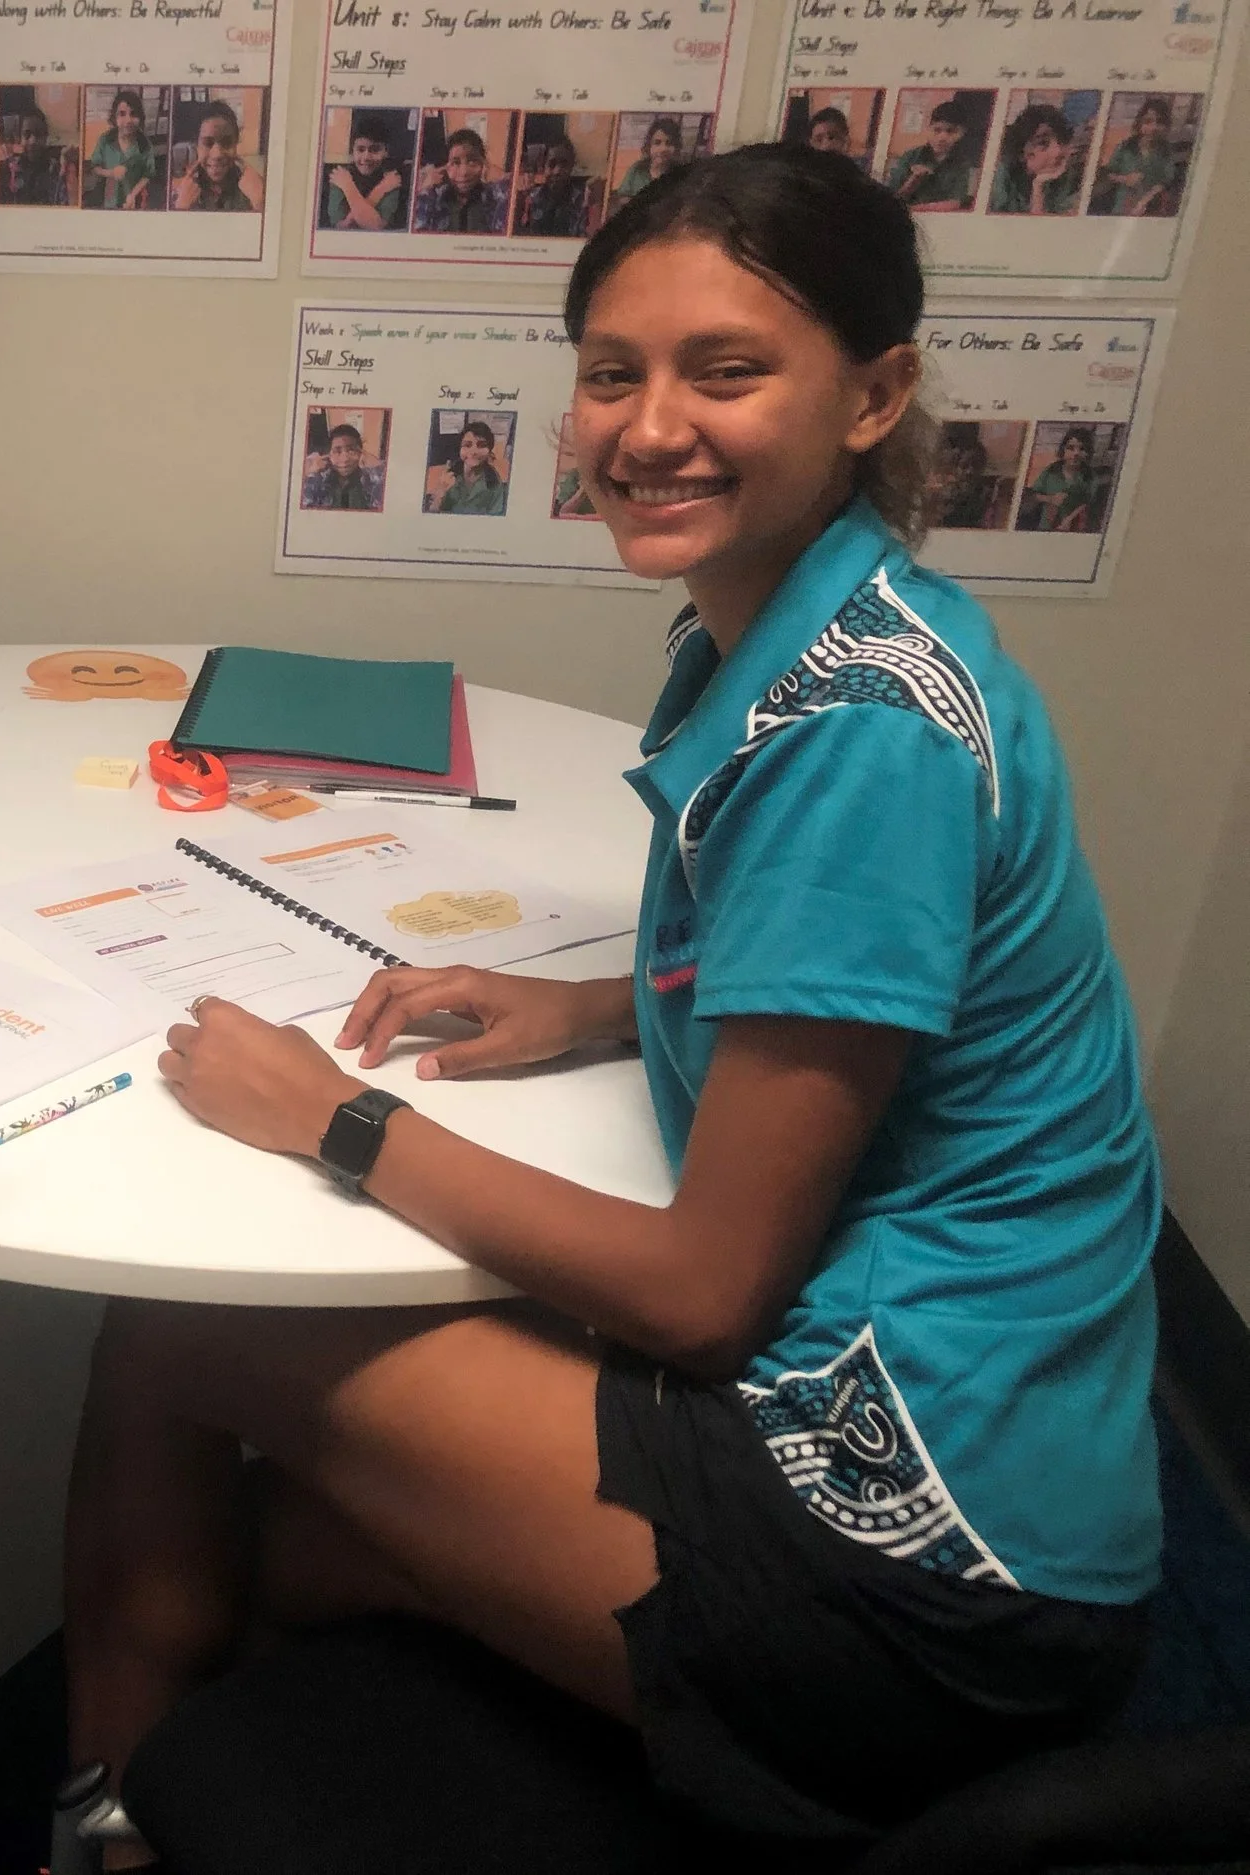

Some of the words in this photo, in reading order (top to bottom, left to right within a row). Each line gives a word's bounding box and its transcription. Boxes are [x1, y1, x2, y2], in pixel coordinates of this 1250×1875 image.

[35, 2, 66, 18] with
[73, 0, 122, 19] Others:
[129, 1, 148, 19] Be
[154, 1, 222, 26] Respectful
[334, 0, 382, 28] Unit
[422, 9, 457, 37] Stay
[464, 10, 501, 29] Calm
[508, 10, 543, 29] with
[550, 10, 603, 30] Others:
[611, 11, 631, 30] Be
[638, 11, 672, 31] Safe
[864, 0, 886, 19] Do
[1033, 0, 1053, 20] Be
[1060, 0, 1077, 20] A
[331, 51, 362, 70] Skill
[367, 51, 407, 78] Steps
[305, 322, 334, 336] Week
[413, 324, 424, 338] if
[425, 330, 448, 344] your
[453, 329, 478, 341] voice
[525, 328, 539, 342] Be
[926, 331, 953, 350] For
[959, 331, 1014, 351] Others:
[1021, 332, 1042, 351] Be
[1049, 333, 1084, 352] Safe
[303, 349, 333, 367] Skill
[337, 350, 375, 374] Steps
[301, 380, 324, 399] Step
[341, 381, 369, 396] Think
[438, 385, 461, 404] Step
[486, 386, 521, 406] Signal
